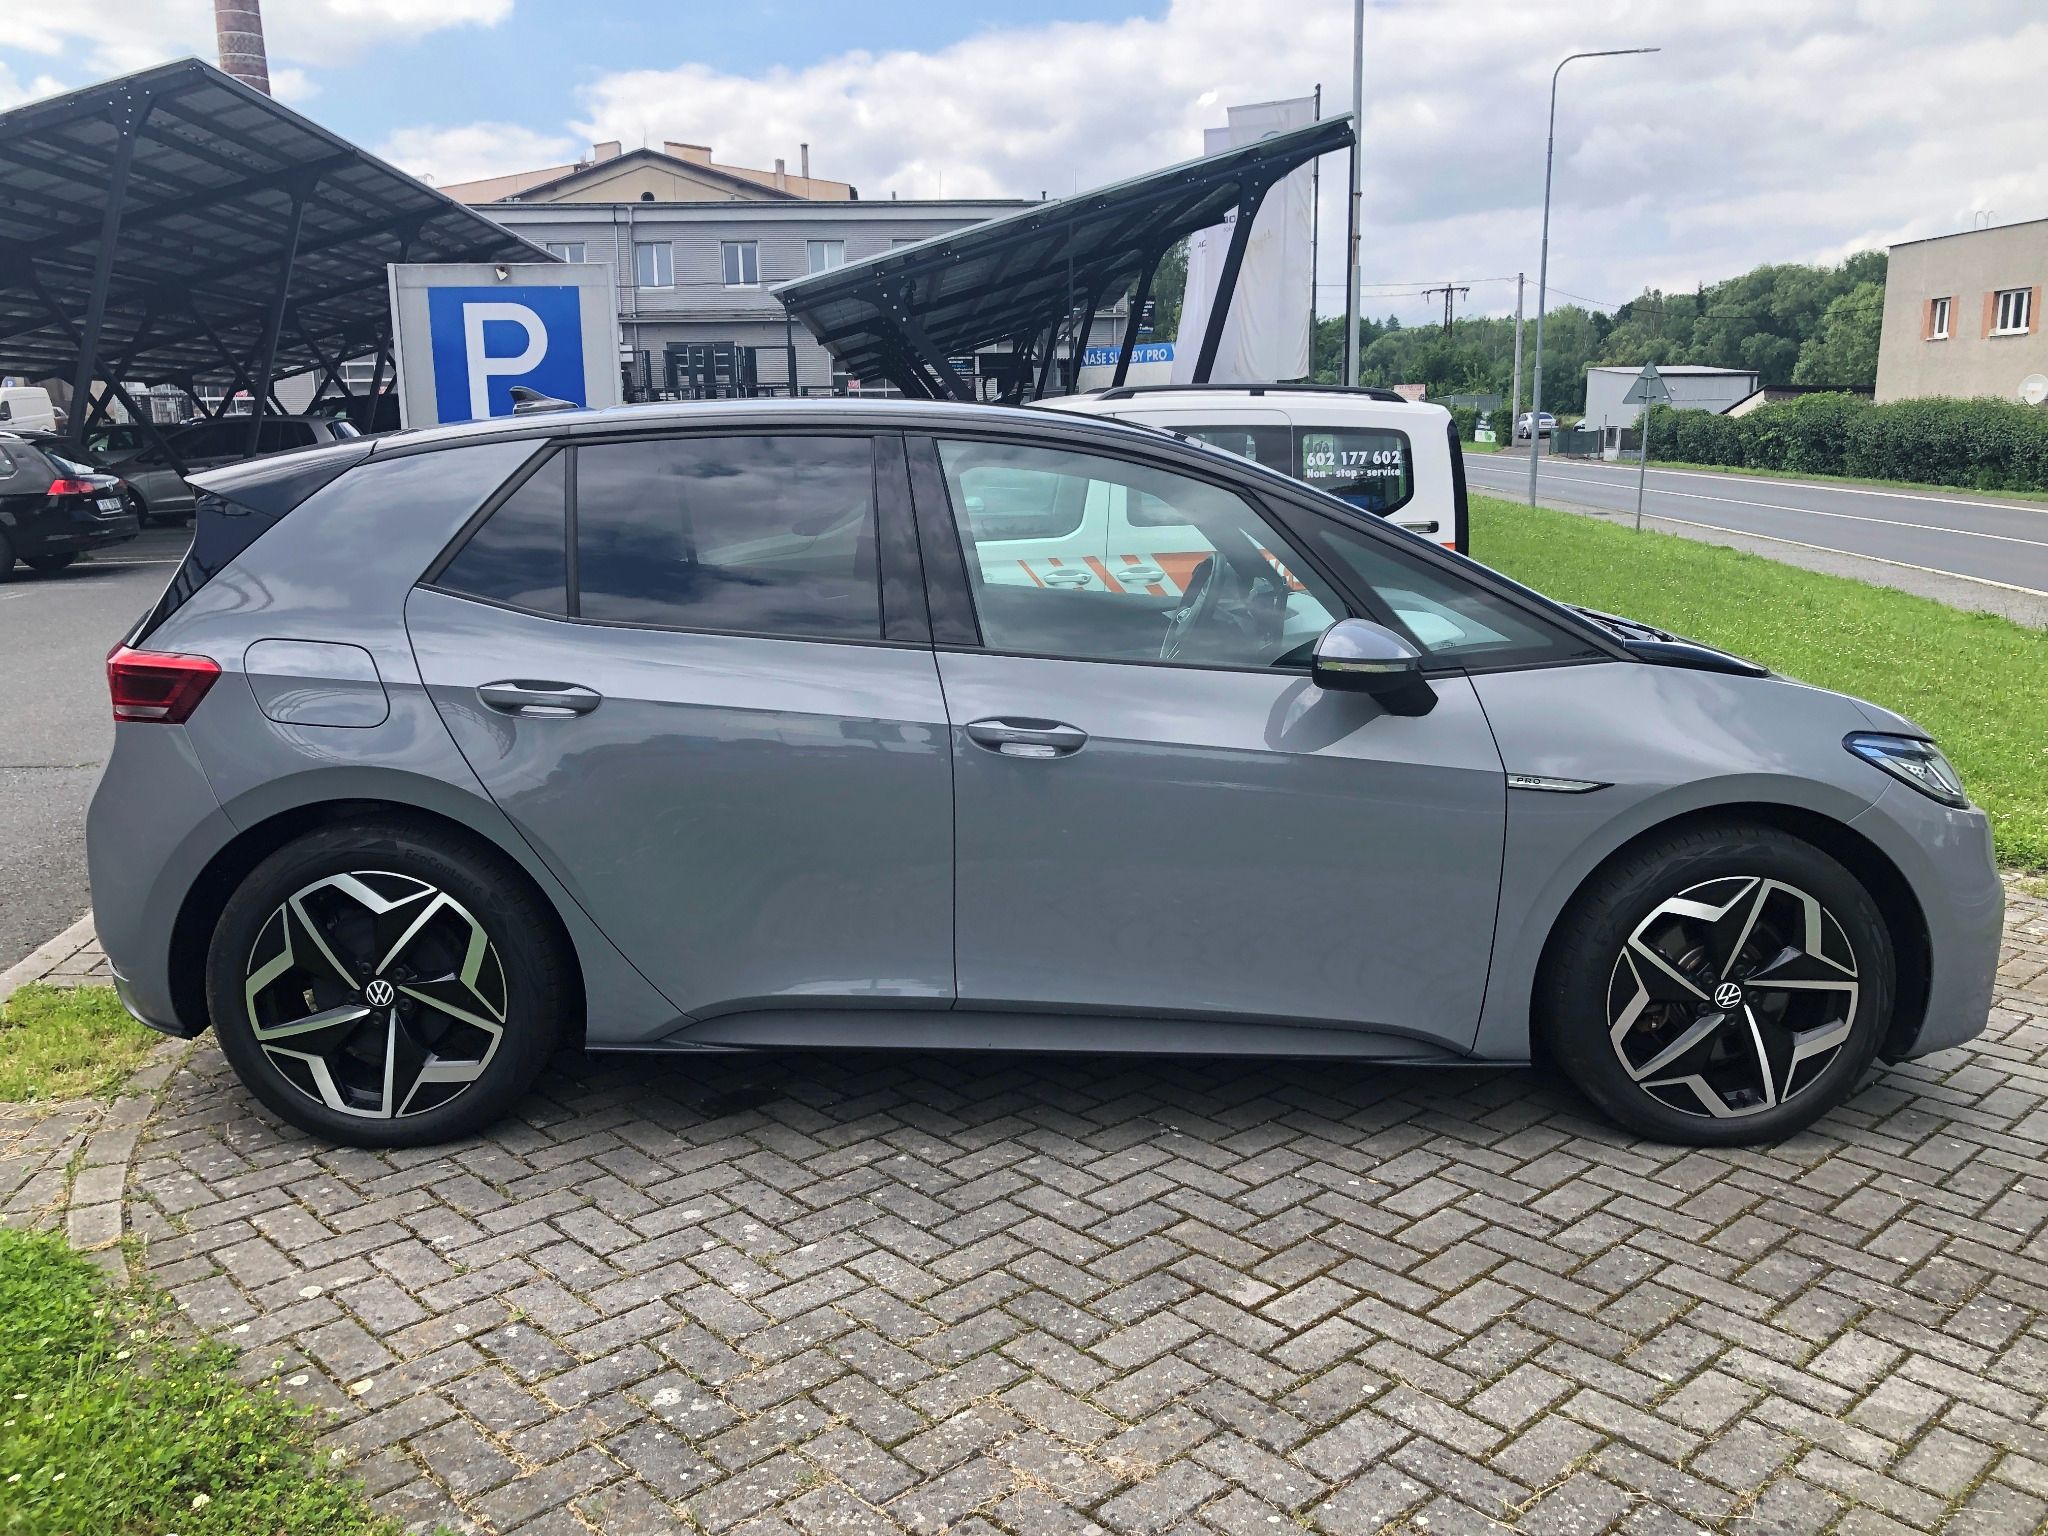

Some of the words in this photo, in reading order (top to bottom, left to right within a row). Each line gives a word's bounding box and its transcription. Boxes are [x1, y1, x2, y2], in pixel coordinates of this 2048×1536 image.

[462, 302, 549, 420] P
[1083, 349, 1107, 365] NAŠE
[1109, 349, 1145, 365] SLBY
[1146, 348, 1168, 362] PRO
[1306, 451, 1335, 467] 602
[1341, 451, 1368, 466] 177
[1372, 450, 1401, 465] 602
[1306, 468, 1326, 478] Non
[1336, 468, 1357, 479] stop
[1366, 466, 1401, 477] service
[1516, 777, 1541, 785] PRO
[405, 849, 474, 890] EcoContact
